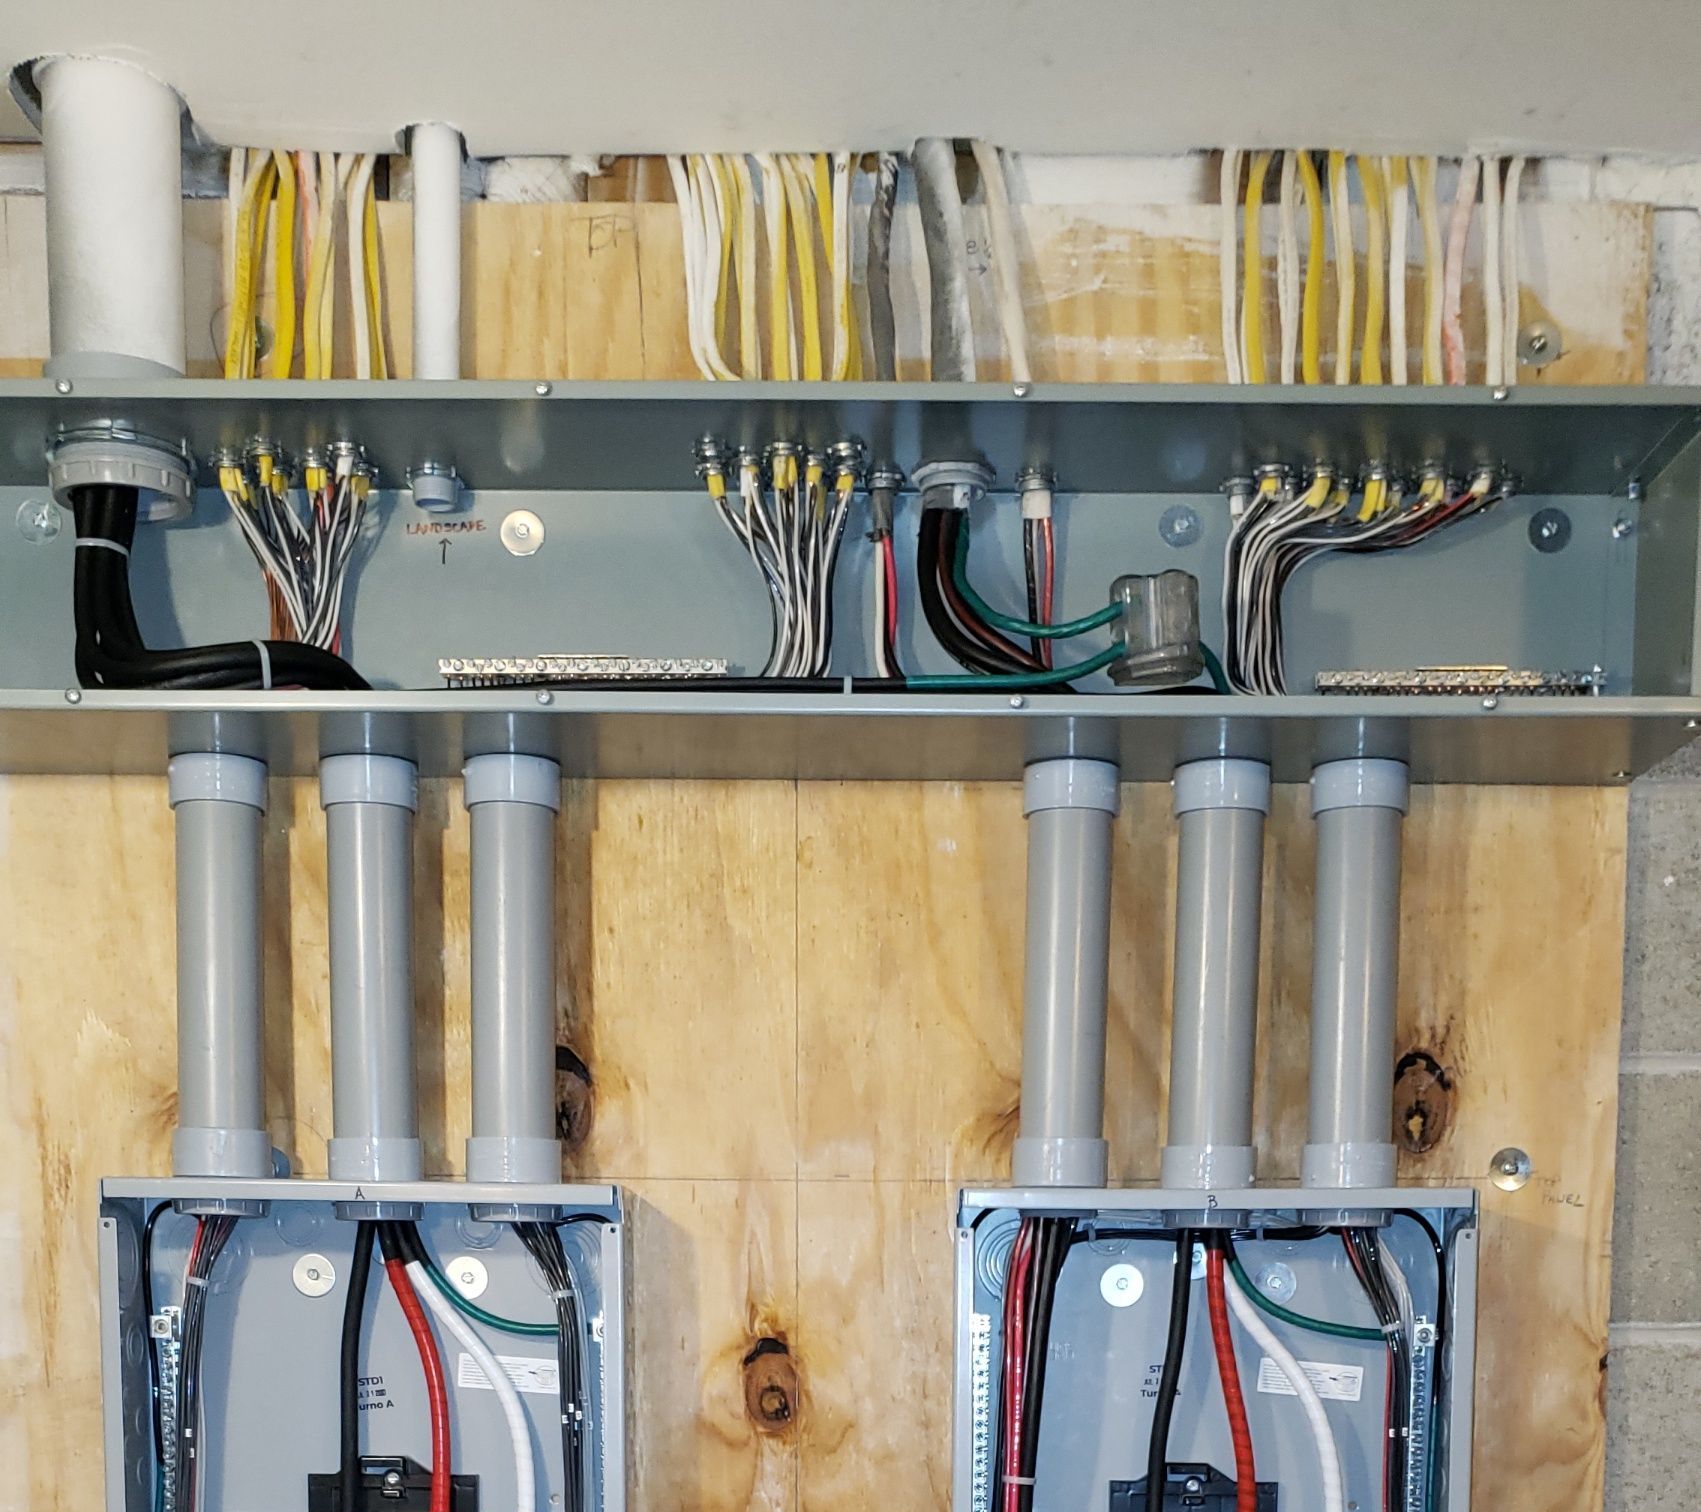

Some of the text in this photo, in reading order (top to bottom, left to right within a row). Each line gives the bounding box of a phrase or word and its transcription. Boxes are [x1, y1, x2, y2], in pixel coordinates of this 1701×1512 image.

[406, 520, 486, 534] LANDSCAPE
[354, 1185, 366, 1200] A
[1207, 1194, 1218, 1210] B
